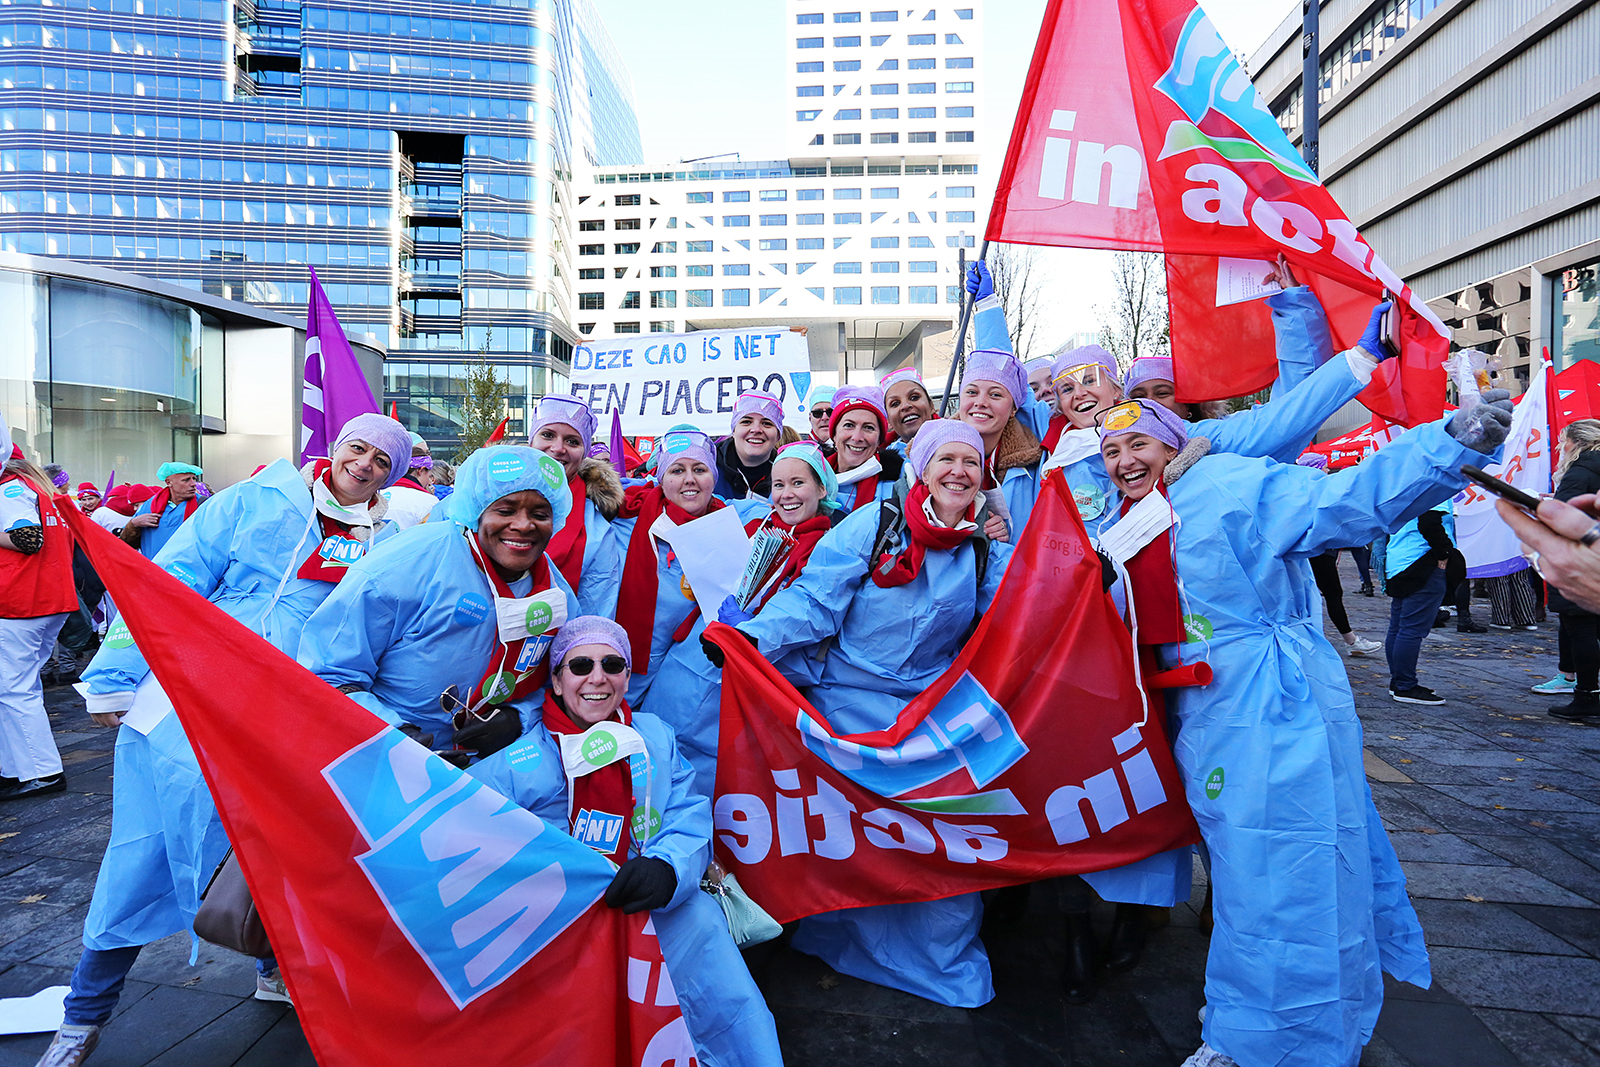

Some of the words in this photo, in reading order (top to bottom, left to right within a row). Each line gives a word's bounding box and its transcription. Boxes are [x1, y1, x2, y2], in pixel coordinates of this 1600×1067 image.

[1037, 109, 1143, 211] in
[573, 345, 633, 370] DEZE
[643, 342, 688, 365] CAO
[734, 333, 781, 361] NET
[323, 538, 363, 559] FNV
[1042, 534, 1070, 557] Zorg
[1074, 541, 1084, 556] is
[533, 608, 545, 618] 5%
[509, 748, 524, 757] GOEDE
[588, 741, 614, 760] ERBIJ!
[589, 737, 604, 748] 5%
[511, 757, 527, 765] GOEDE
[573, 818, 622, 843] FNV
